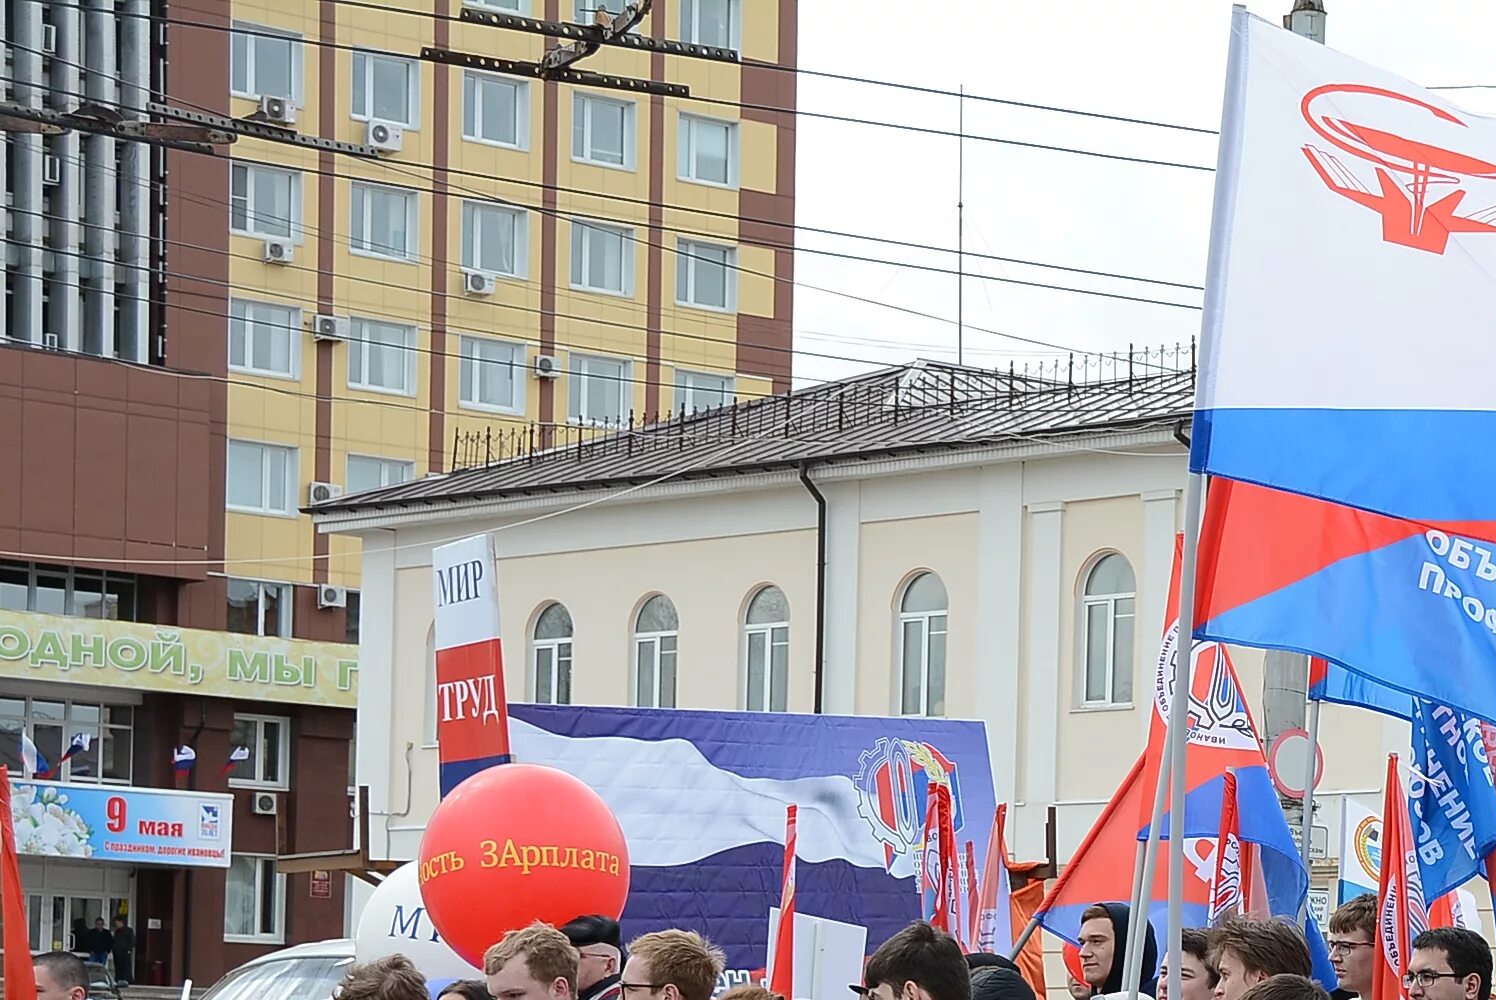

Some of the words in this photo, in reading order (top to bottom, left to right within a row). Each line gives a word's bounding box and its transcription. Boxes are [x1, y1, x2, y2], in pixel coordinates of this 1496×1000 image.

[437, 560, 484, 607] МИР
[438, 675, 499, 725] ТРУД
[105, 796, 127, 833] 9
[138, 820, 184, 838] мая
[480, 839, 620, 877] ЗАрплата
